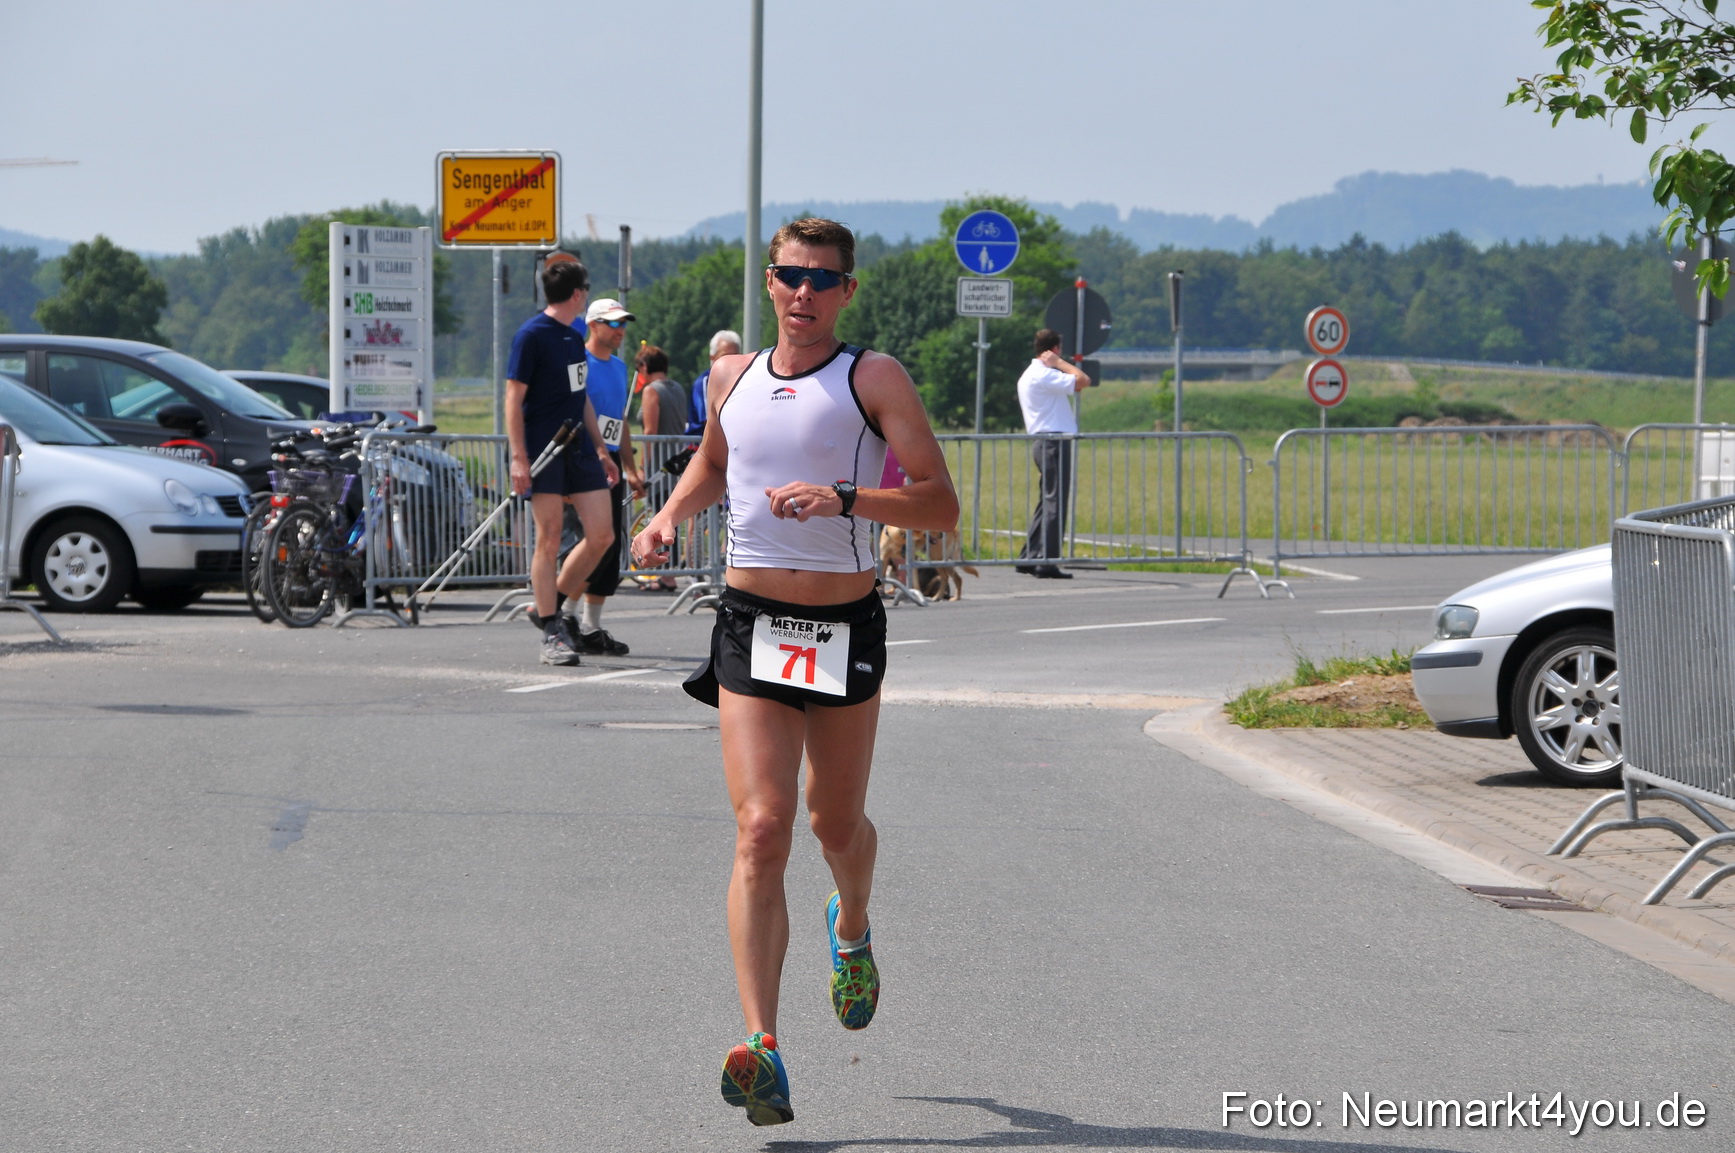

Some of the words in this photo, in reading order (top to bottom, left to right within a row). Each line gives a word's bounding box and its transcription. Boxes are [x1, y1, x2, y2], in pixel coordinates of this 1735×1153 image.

[452, 168, 545, 194] Sengenthal
[464, 198, 485, 208] am
[491, 196, 532, 211] Anger
[475, 219, 516, 231] Neumarkt
[375, 229, 412, 243] HOLZAMMER
[375, 260, 412, 274] HOLZAMMER
[375, 296, 412, 312] Holzfachmarkt
[1317, 321, 1340, 342] 60
[603, 420, 620, 441] 68
[770, 617, 813, 633] MEYER
[770, 628, 813, 641] WERBUNG
[779, 643, 817, 684] 71
